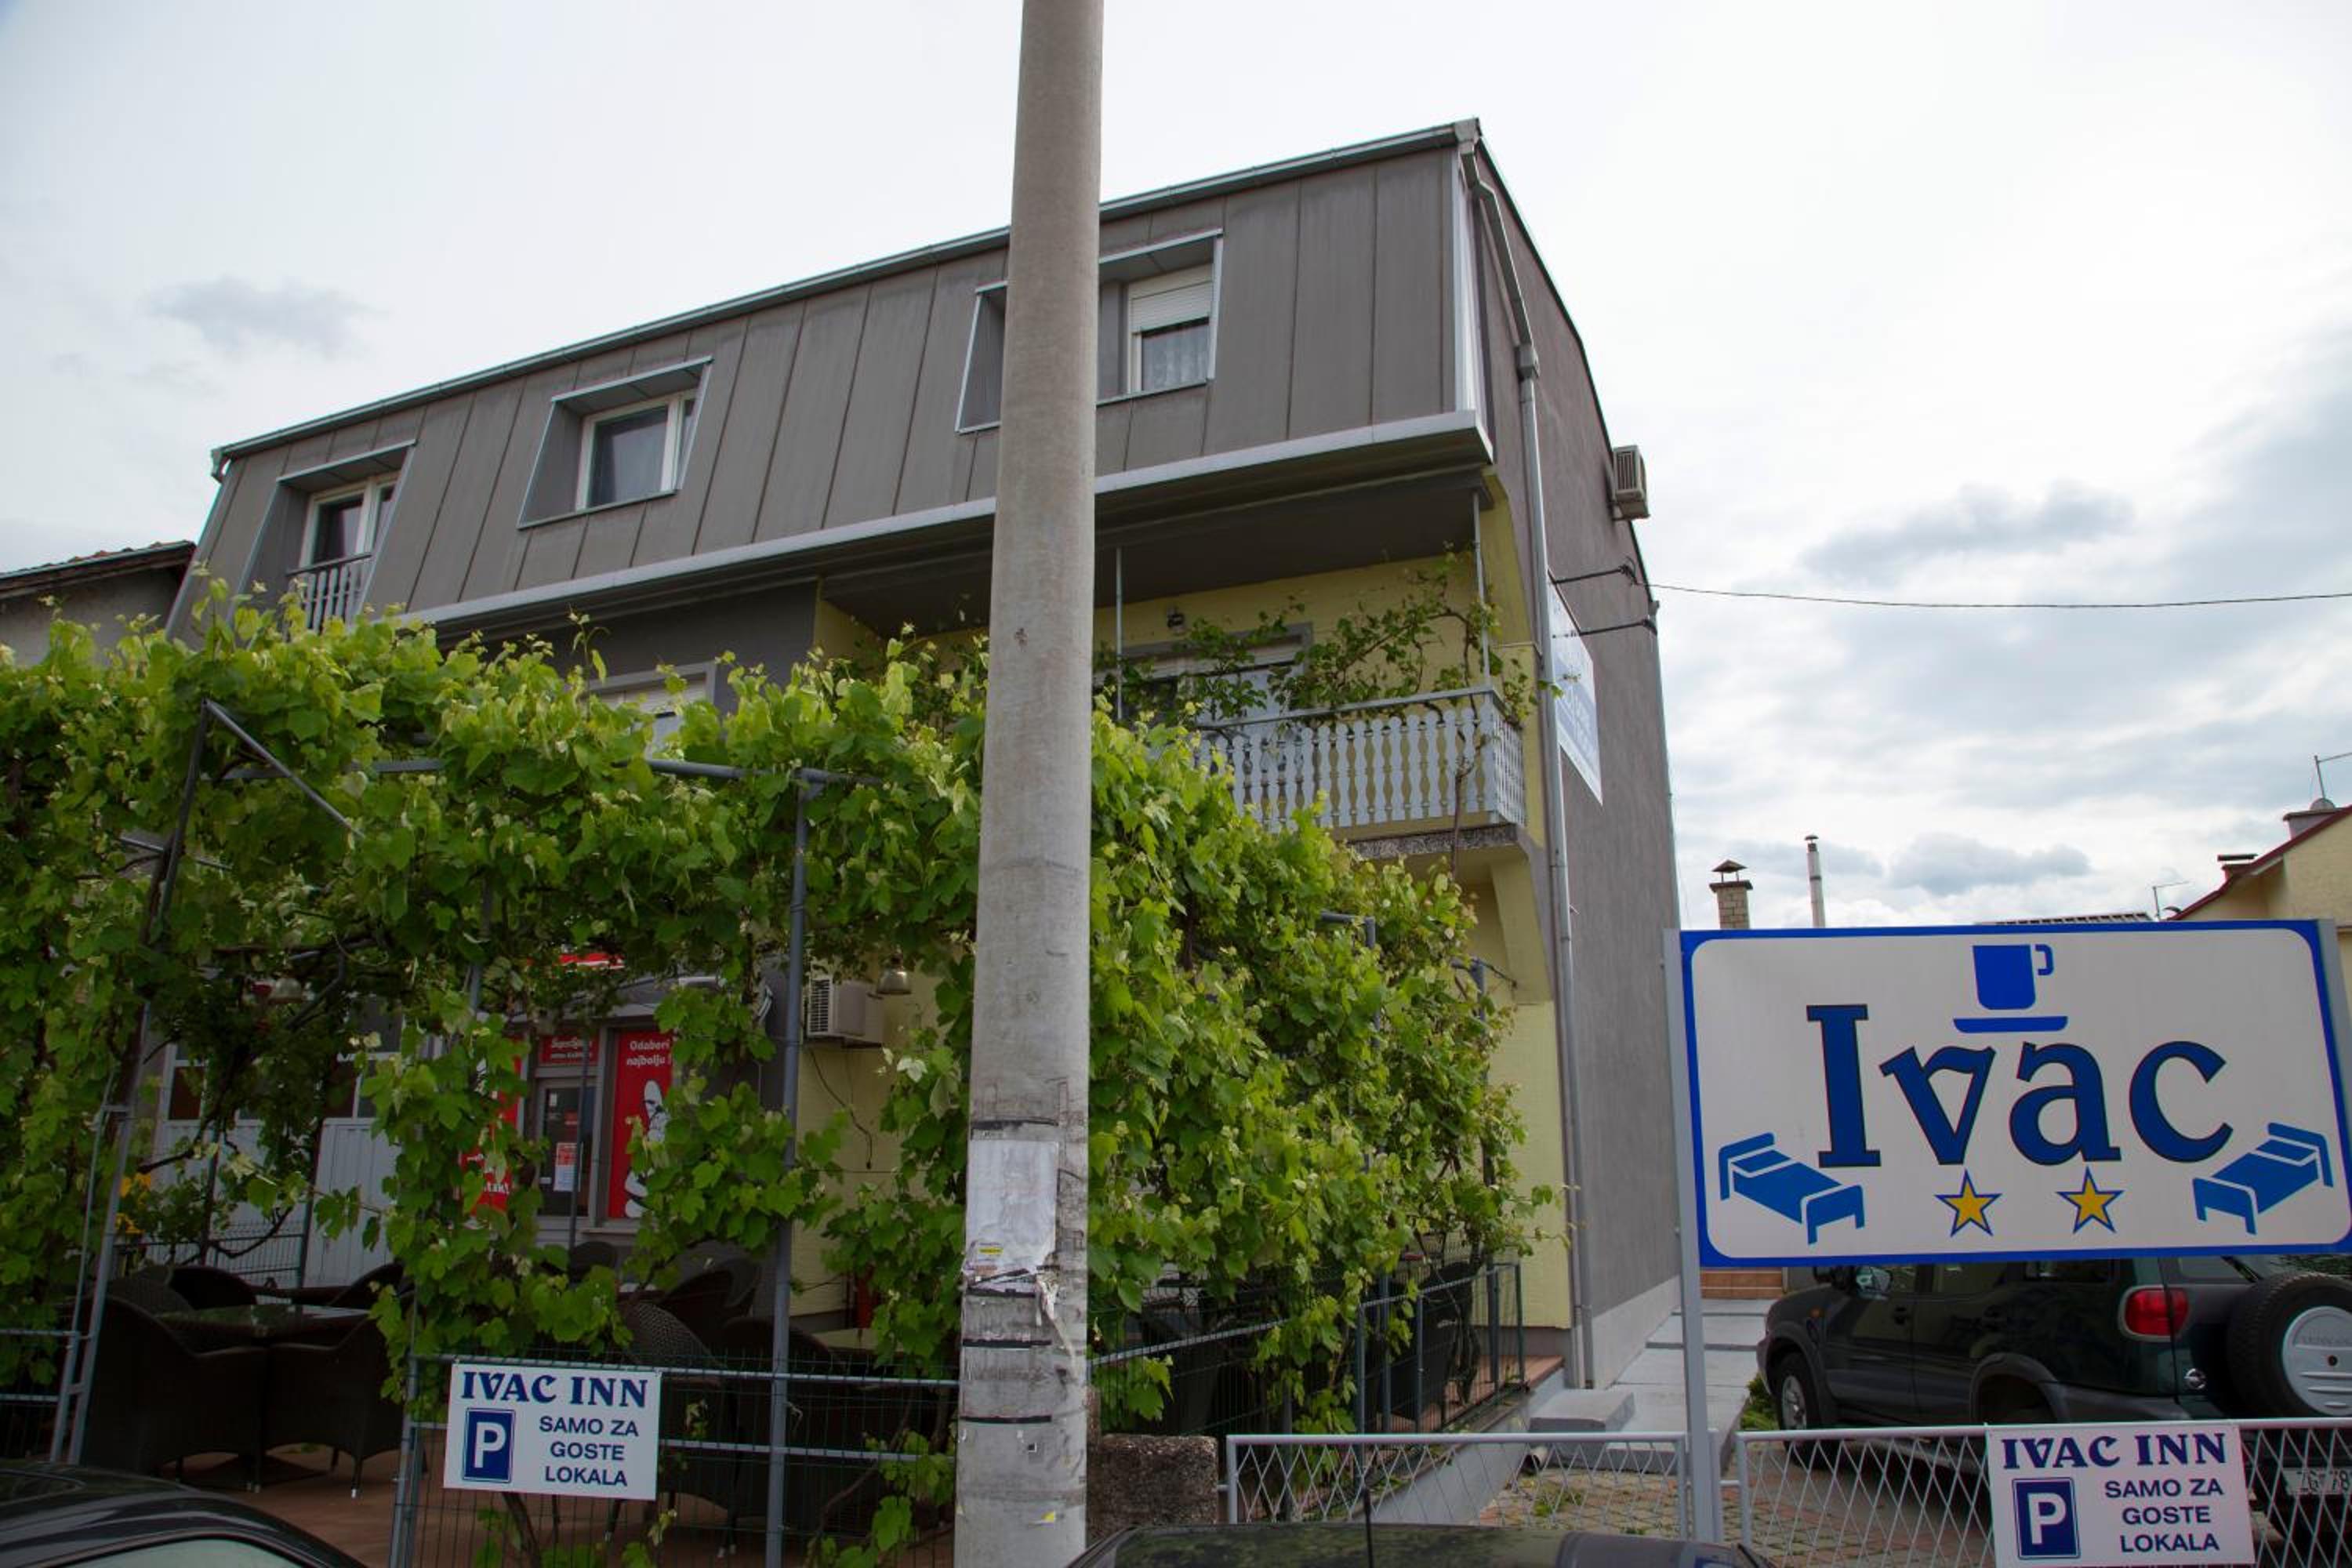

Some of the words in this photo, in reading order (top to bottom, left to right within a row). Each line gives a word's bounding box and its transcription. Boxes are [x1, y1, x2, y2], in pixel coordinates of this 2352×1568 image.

[630, 1039, 670, 1051] Odaberi
[626, 1054, 665, 1068] najbolju
[1806, 1004, 2234, 1168] Ivac
[461, 1371, 557, 1403] IVAC
[570, 1376, 648, 1408] INN
[539, 1415, 604, 1435] SAMO
[610, 1420, 639, 1437] ZA
[474, 1421, 506, 1468] P
[550, 1441, 626, 1461] GOSTE
[2001, 1436, 2121, 1470] IVAC
[2134, 1432, 2226, 1466] INN
[544, 1465, 628, 1487] LOKALA
[2104, 1479, 2181, 1499] SAMO
[2189, 1478, 2224, 1497] ZA
[2026, 1492, 2067, 1545] P
[2122, 1505, 2212, 1526] GOSTE
[2119, 1532, 2220, 1553] LOKALA
